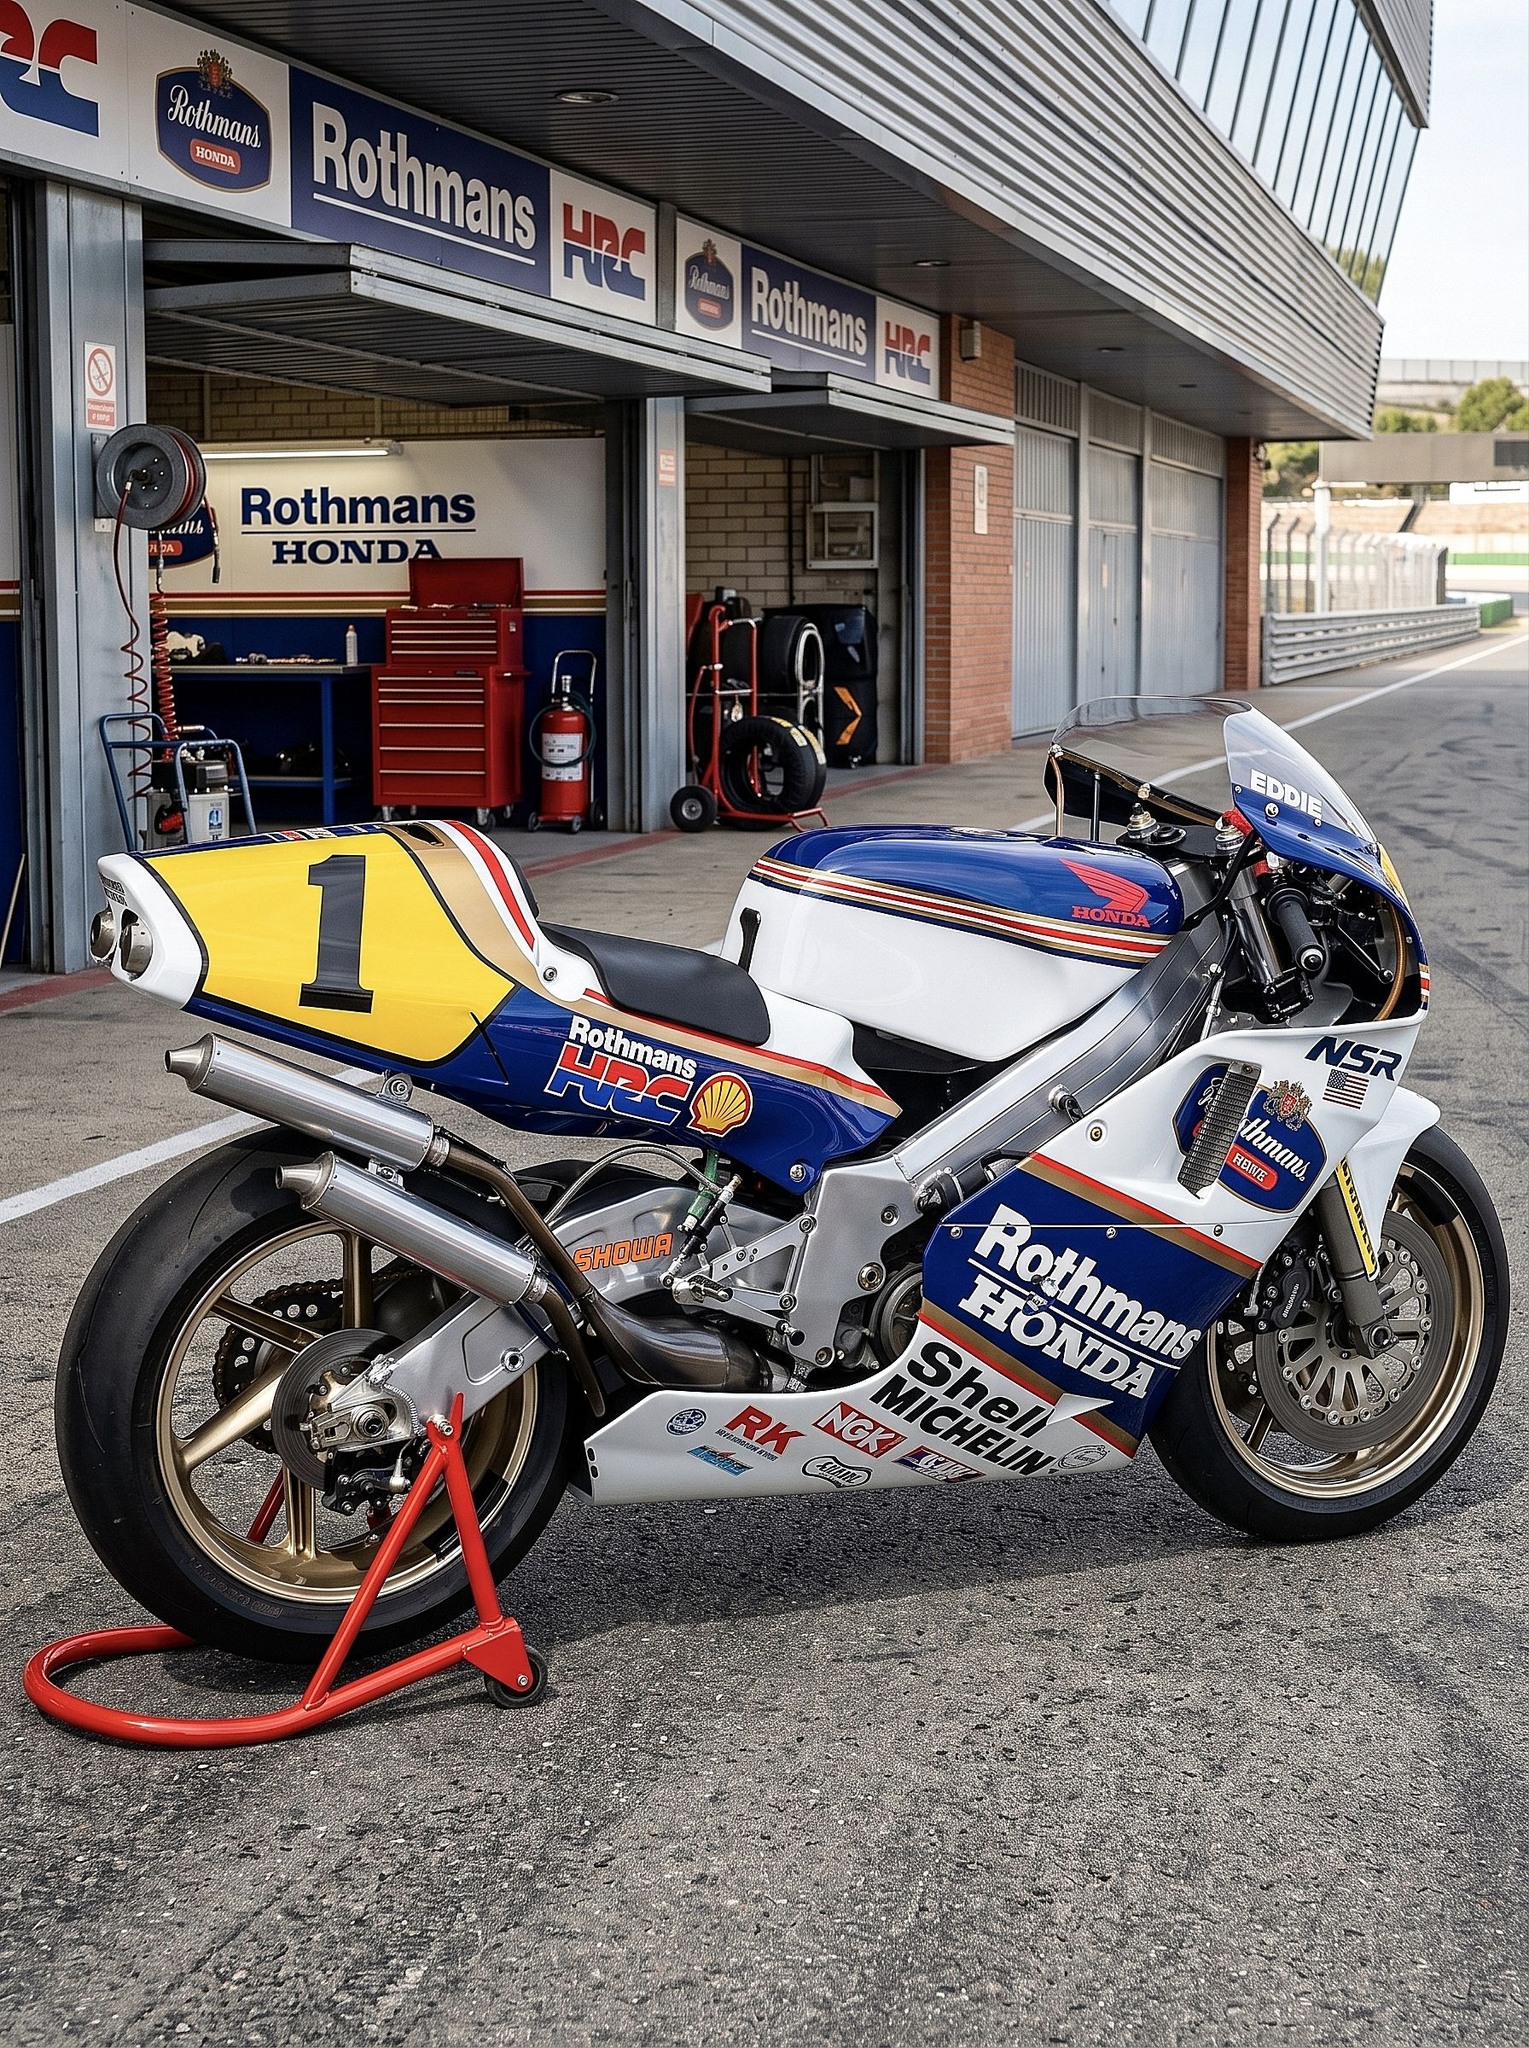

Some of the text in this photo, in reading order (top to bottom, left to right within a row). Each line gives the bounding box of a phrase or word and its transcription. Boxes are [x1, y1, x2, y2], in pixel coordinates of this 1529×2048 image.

[195, 146, 236, 168] HONDA
[312, 101, 536, 250] Rothmans
[562, 202, 646, 301] HRC
[751, 266, 868, 356] Rothmans
[885, 321, 931, 385] HRC
[241, 487, 476, 526] Rothmans
[271, 539, 443, 565] HONDA
[1250, 768, 1322, 820] EDDIE
[299, 855, 374, 1014] 1
[1071, 905, 1151, 928] HONDA
[568, 1014, 698, 1080] Rothmans
[1304, 1035, 1404, 1082] NSR
[544, 1041, 694, 1126] HRC
[573, 1231, 674, 1273] SHOWA
[974, 1203, 1202, 1360] Rothmans
[958, 1273, 1156, 1400] HONDA
[906, 1341, 1056, 1439] Shell
[724, 1404, 807, 1455] RK
[818, 1404, 896, 1453] NGK
[869, 1373, 1056, 1477] MICHELIN
